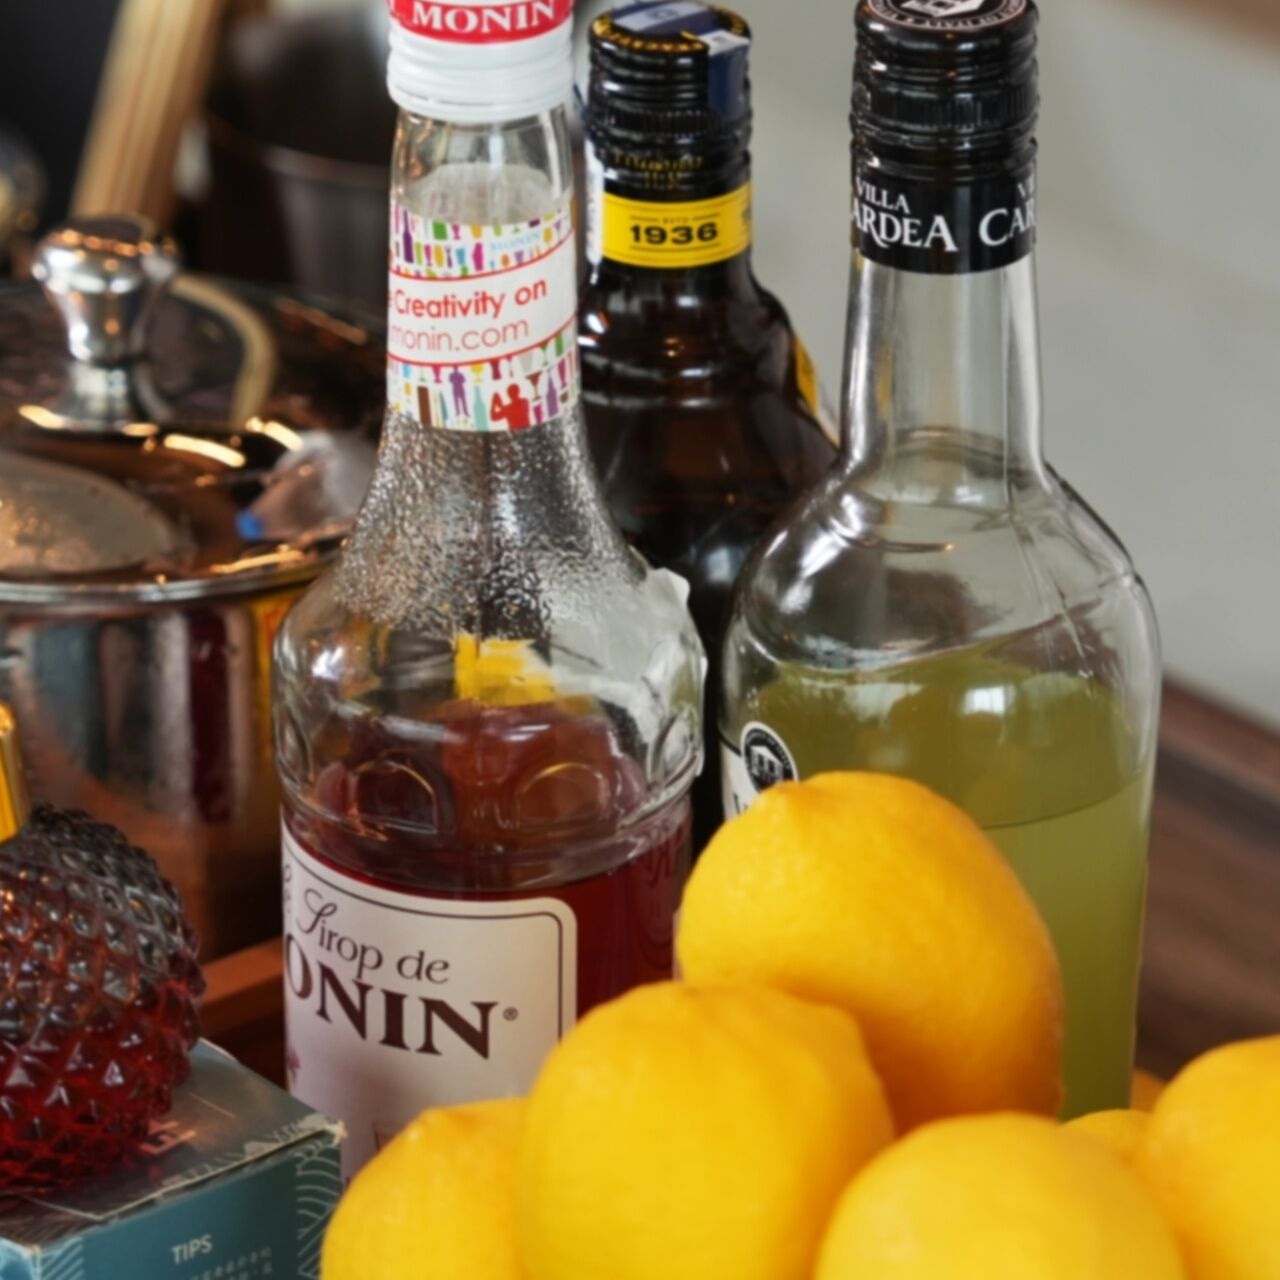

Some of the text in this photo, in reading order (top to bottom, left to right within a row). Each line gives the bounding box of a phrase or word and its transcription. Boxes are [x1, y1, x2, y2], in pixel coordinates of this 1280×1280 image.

[855, 175, 911, 215] VILLA
[631, 222, 718, 245] 1936
[852, 197, 960, 252] ARDEA
[394, 279, 547, 319] Creativity on
[297, 888, 383, 979] Sirop
[396, 950, 450, 984] de
[285, 932, 499, 1060] ONIN
[171, 1234, 212, 1265] TIPS
